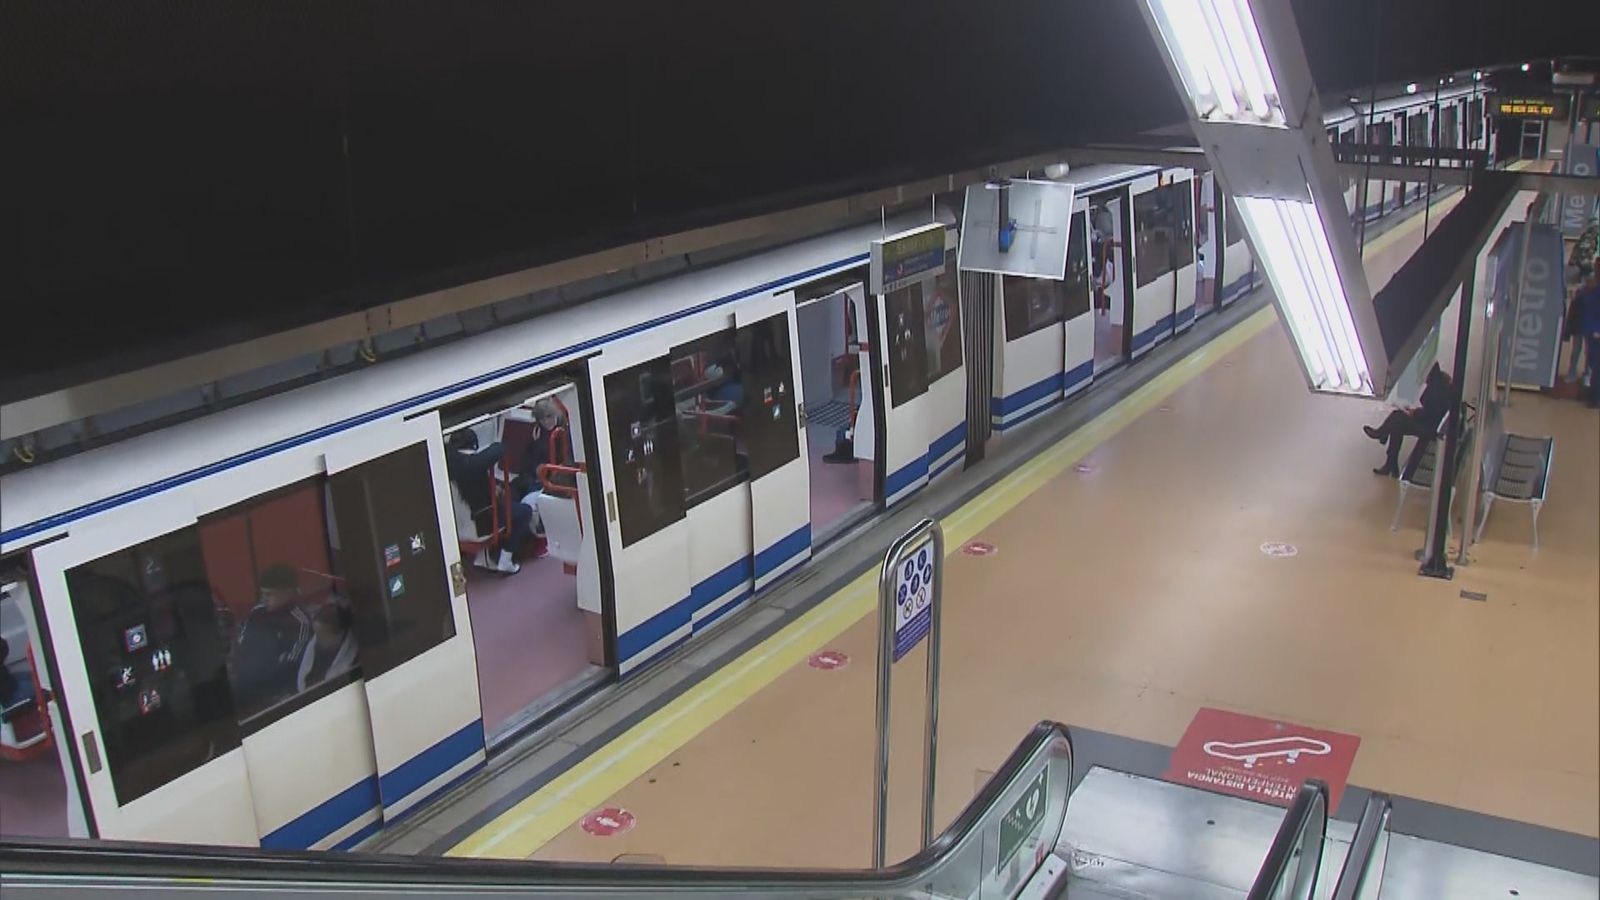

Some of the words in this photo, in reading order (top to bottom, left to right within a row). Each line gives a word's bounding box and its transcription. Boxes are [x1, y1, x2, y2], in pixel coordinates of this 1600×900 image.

[1565, 163, 1590, 228] Meo
[1513, 256, 1550, 370] Metro
[1187, 770, 1245, 789] DISTANCIA
[1206, 768, 1297, 793] NTERPERSONAL
[1248, 784, 1262, 793] LA
[1264, 788, 1296, 801] NTÉN
